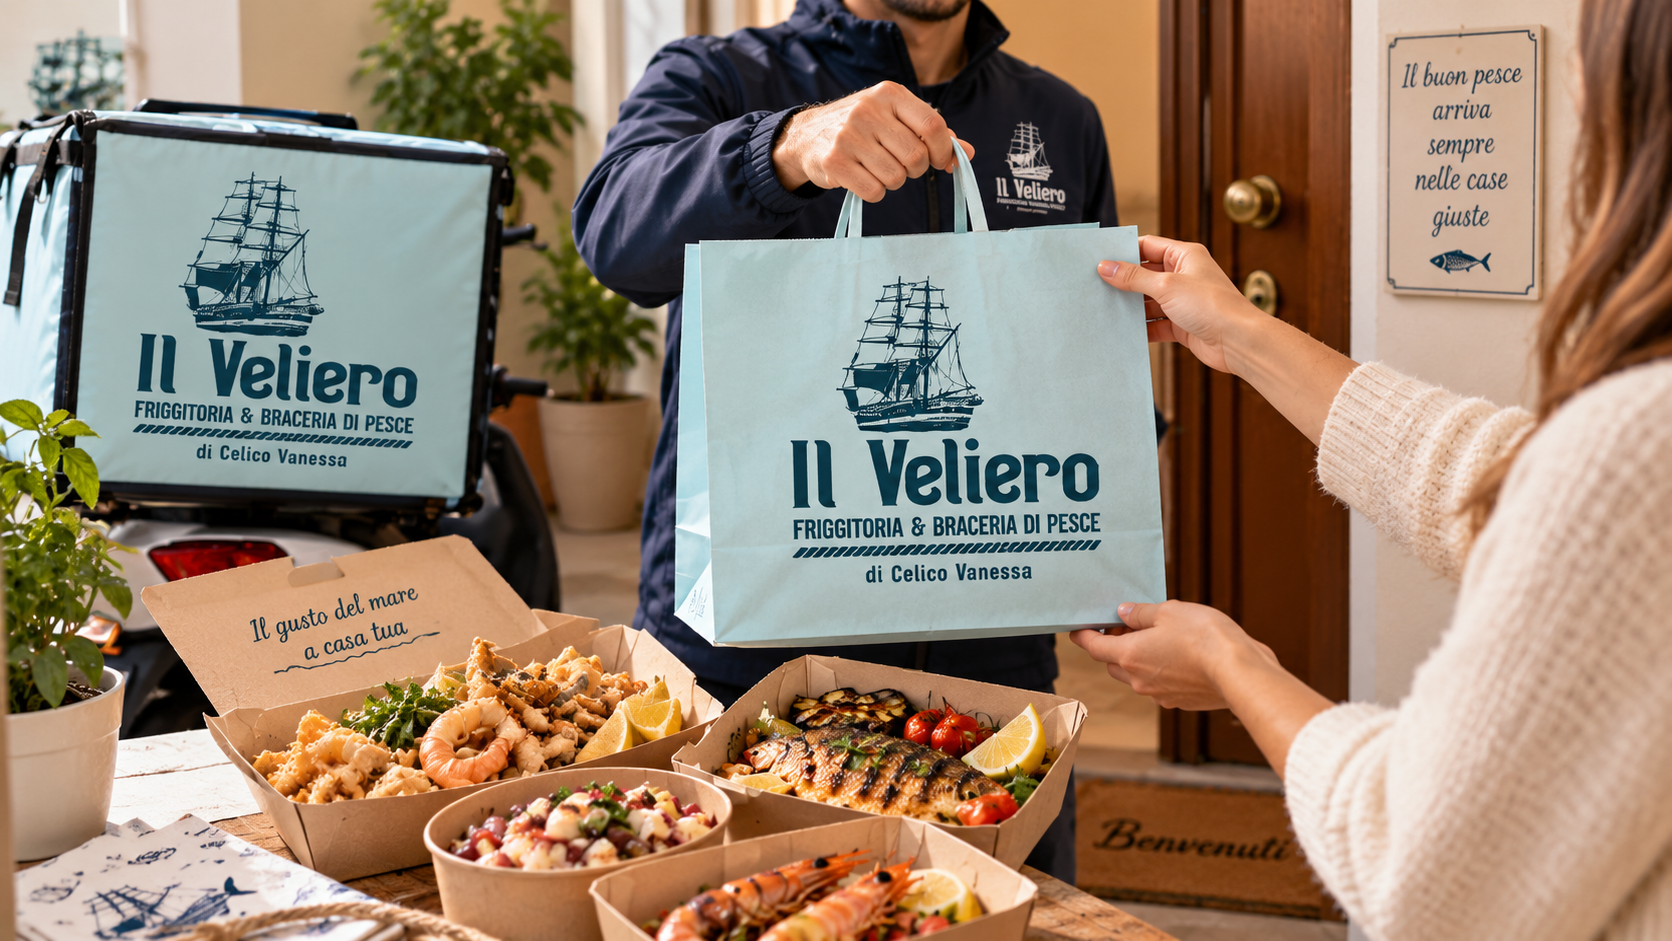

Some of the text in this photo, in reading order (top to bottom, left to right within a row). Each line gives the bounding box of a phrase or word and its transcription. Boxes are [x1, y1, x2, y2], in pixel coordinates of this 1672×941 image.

[1402, 62, 1522, 94] Il buon pesce
[1433, 99, 1492, 120] arriva
[1428, 138, 1494, 163] sempre
[996, 177, 1009, 197] Il
[1013, 178, 1066, 204] Veliero
[1415, 165, 1508, 190] nelle case
[1432, 205, 1489, 237] giuste
[137, 333, 418, 409] Il Veliero
[135, 400, 414, 434] FRIGGITORIA & BRACERIA DI PESCE
[197, 444, 347, 467] di Celico Vanessa
[791, 438, 1099, 508] Il Veliero
[794, 513, 1100, 539] FRIGGITORIA & BRACERIA DI PESCE
[866, 563, 1032, 583] di Celico Vanessa
[250, 588, 418, 643] Il gusto del mare
[305, 622, 408, 660] a casa tua
[1093, 817, 1290, 861] Benvenuti
